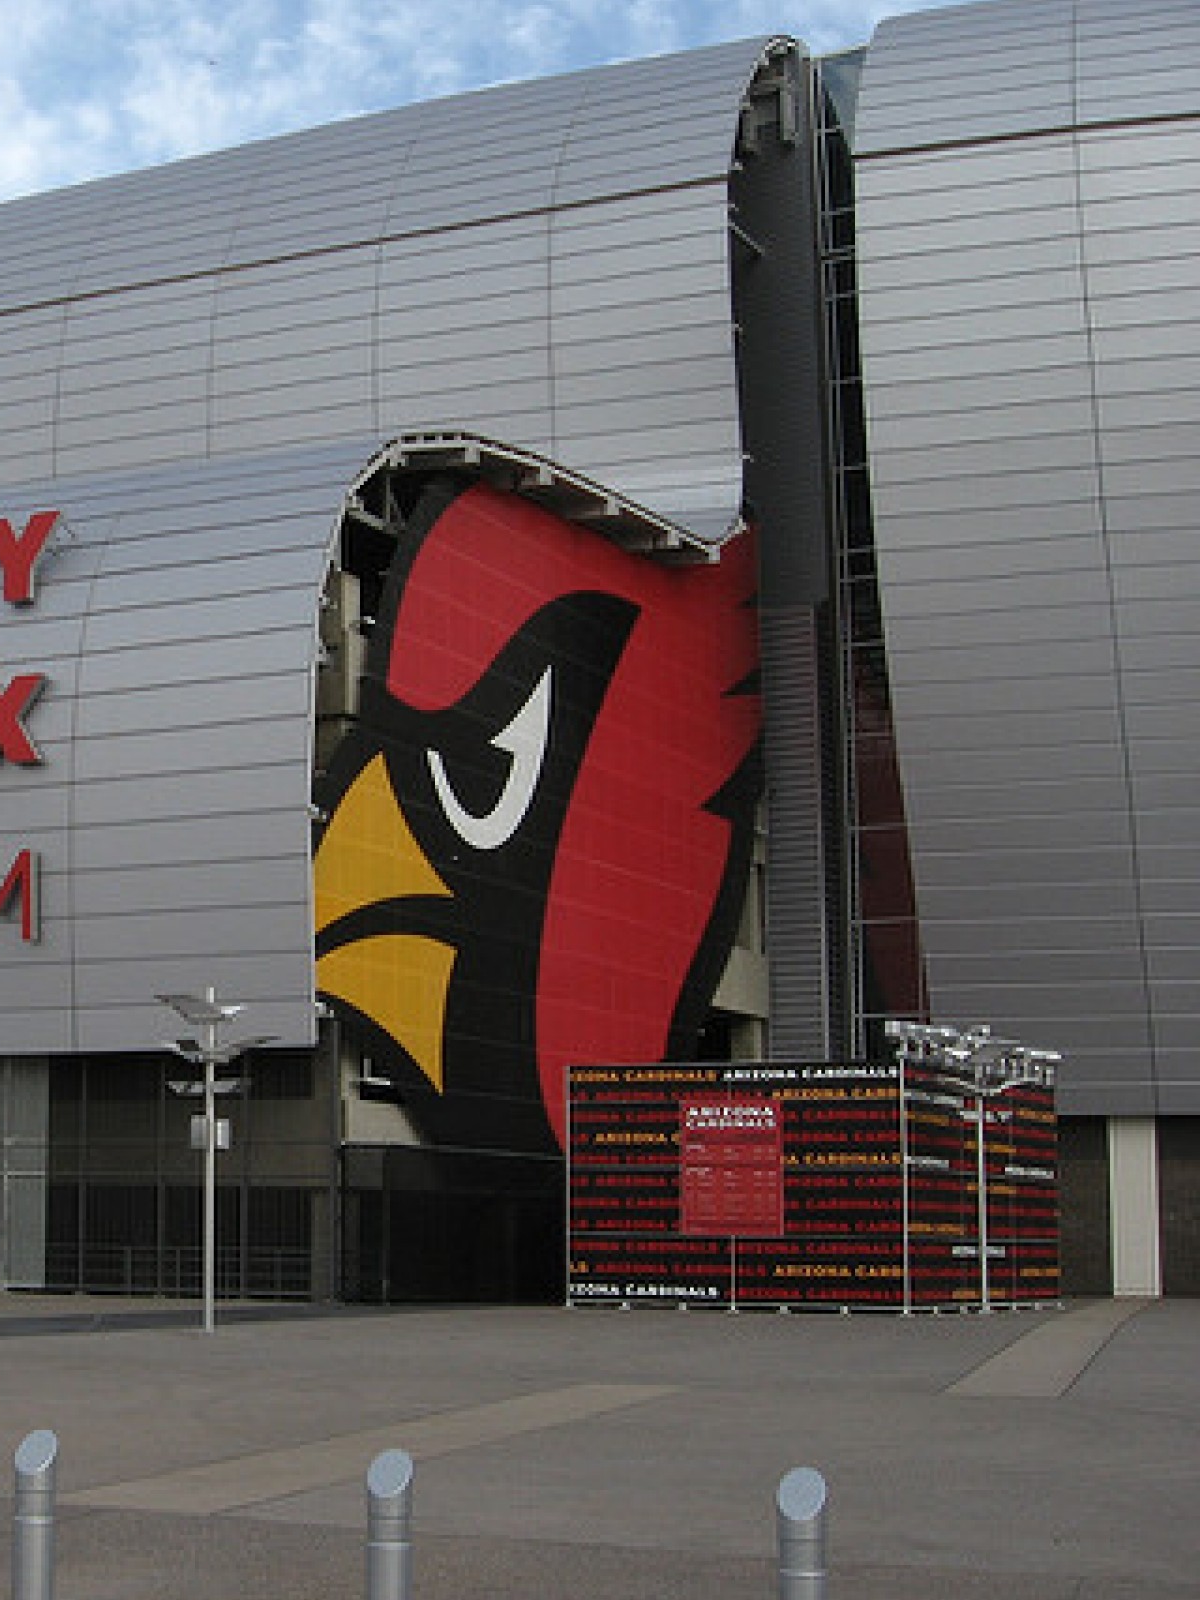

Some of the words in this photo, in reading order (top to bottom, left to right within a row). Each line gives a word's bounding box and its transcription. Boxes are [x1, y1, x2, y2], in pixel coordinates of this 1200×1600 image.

[722, 1067, 798, 1081] ARIZONA
[802, 1065, 898, 1080] CARDINALS
[771, 1087, 848, 1100] ARIZONA
[688, 1106, 773, 1118] ARIZONA
[685, 1118, 776, 1131] CARDINALS
[593, 1132, 668, 1145] ARIZONA
[773, 1264, 852, 1277] ARIZONA
